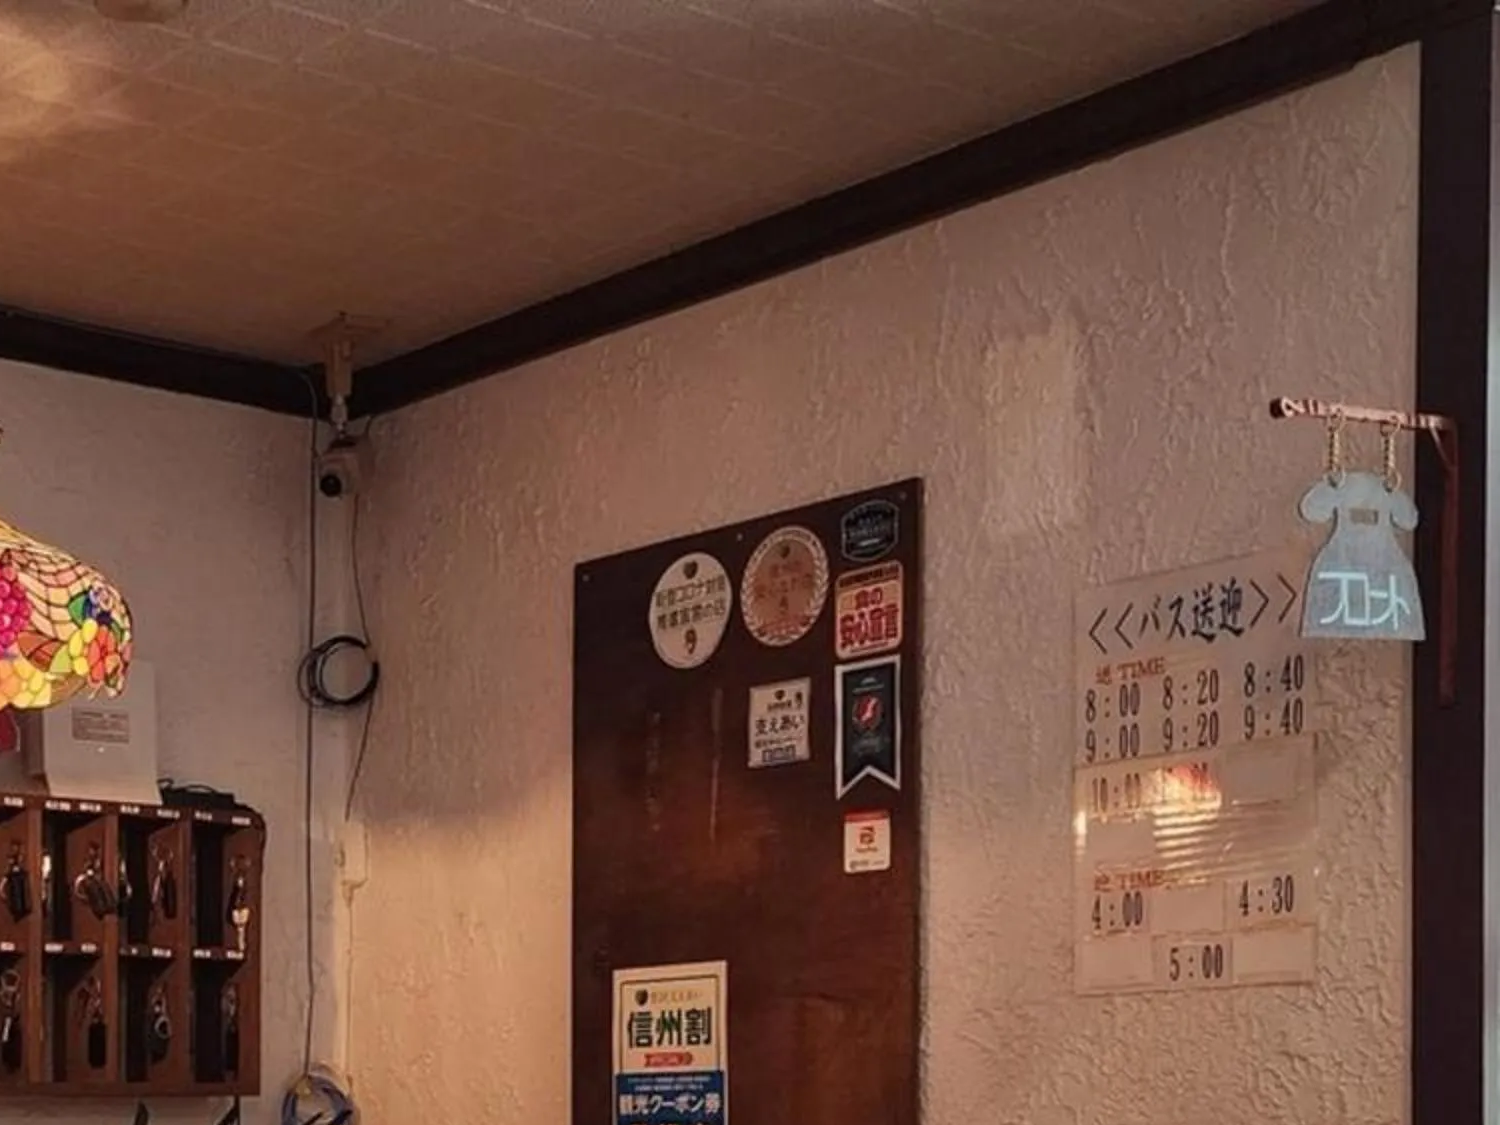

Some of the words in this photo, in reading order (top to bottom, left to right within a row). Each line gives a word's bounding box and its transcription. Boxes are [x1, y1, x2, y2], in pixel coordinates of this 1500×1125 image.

[1085, 682, 1141, 724] 8:00
[1162, 668, 1220, 711] 8:20
[1244, 654, 1304, 698] 8:40
[1085, 722, 1141, 764] 9:00
[1162, 709, 1220, 751] 9:20
[1244, 697, 1303, 741] 9:40
[1091, 890, 1143, 930] 4:00
[1239, 874, 1295, 917] 4:30
[1168, 944, 1224, 982] 5:00
[627, 1007, 712, 1048] 信州割
